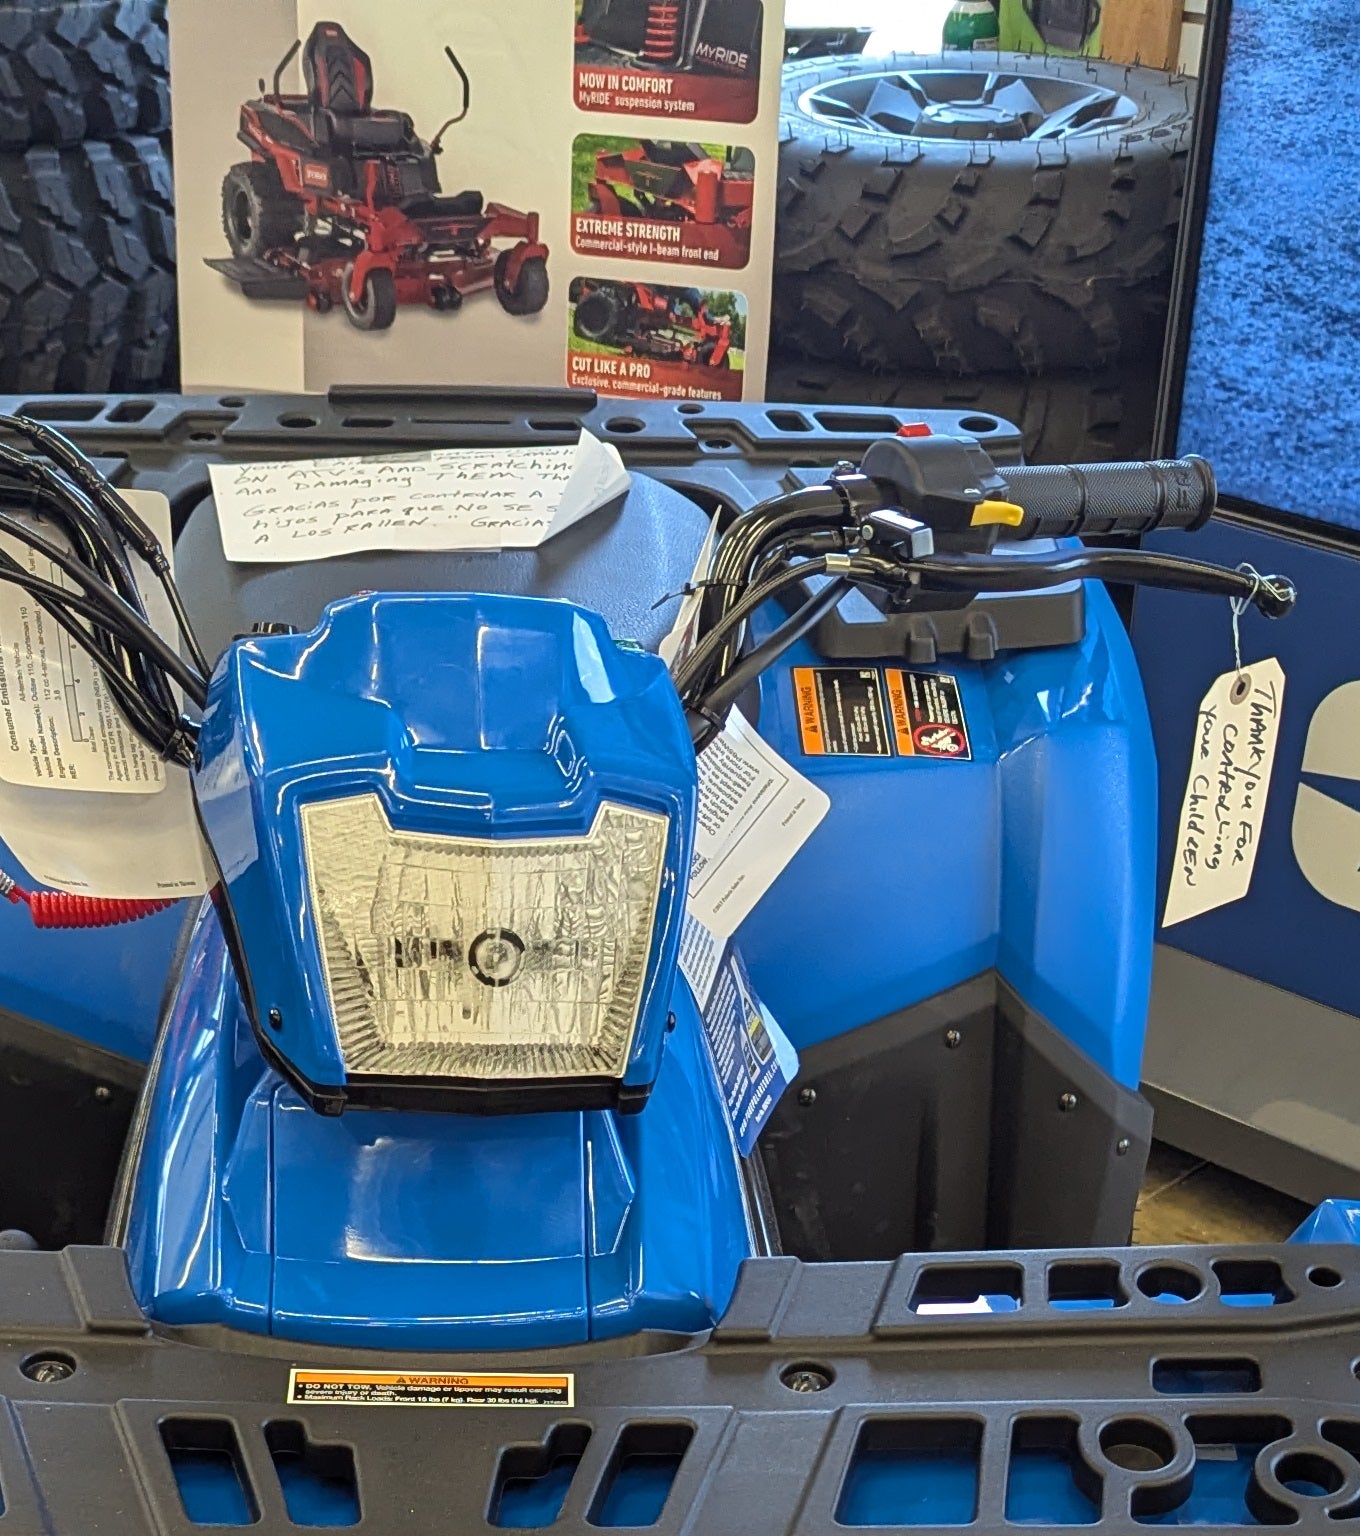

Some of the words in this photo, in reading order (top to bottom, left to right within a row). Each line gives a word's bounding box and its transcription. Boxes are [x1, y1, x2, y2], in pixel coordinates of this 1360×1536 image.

[579, 72, 605, 89] MOW
[607, 75, 619, 90] IN
[622, 75, 674, 94] COMFORT
[615, 95, 663, 110] suspension
[664, 98, 695, 113] system
[575, 217, 623, 237] EXTREME
[625, 222, 681, 242] STRENGTH
[575, 235, 648, 256] Commercial-style
[649, 242, 680, 257] I-beam
[681, 245, 702, 260] front
[703, 248, 719, 261] end
[572, 356, 592, 372] CUT
[594, 358, 618, 376] LIKE
[619, 362, 627, 377] A
[629, 362, 651, 379] PRO
[612, 379, 687, 398] commercial-grade
[688, 385, 722, 400] features
[20, 606, 28, 619] 110
[23, 621, 33, 659] Sportsman
[801, 686, 814, 723] WARNING
[891, 689, 906, 725] WARNING
[4, 708, 19, 751] Consumer
[719, 758, 751, 787] frequently
[725, 755, 742, 771] more
[743, 770, 756, 781] For
[705, 785, 720, 800] birth
[710, 799, 729, 816] which
[720, 798, 734, 811] and
[407, 1385, 441, 1393] damage
[408, 1376, 469, 1385] WARNING
